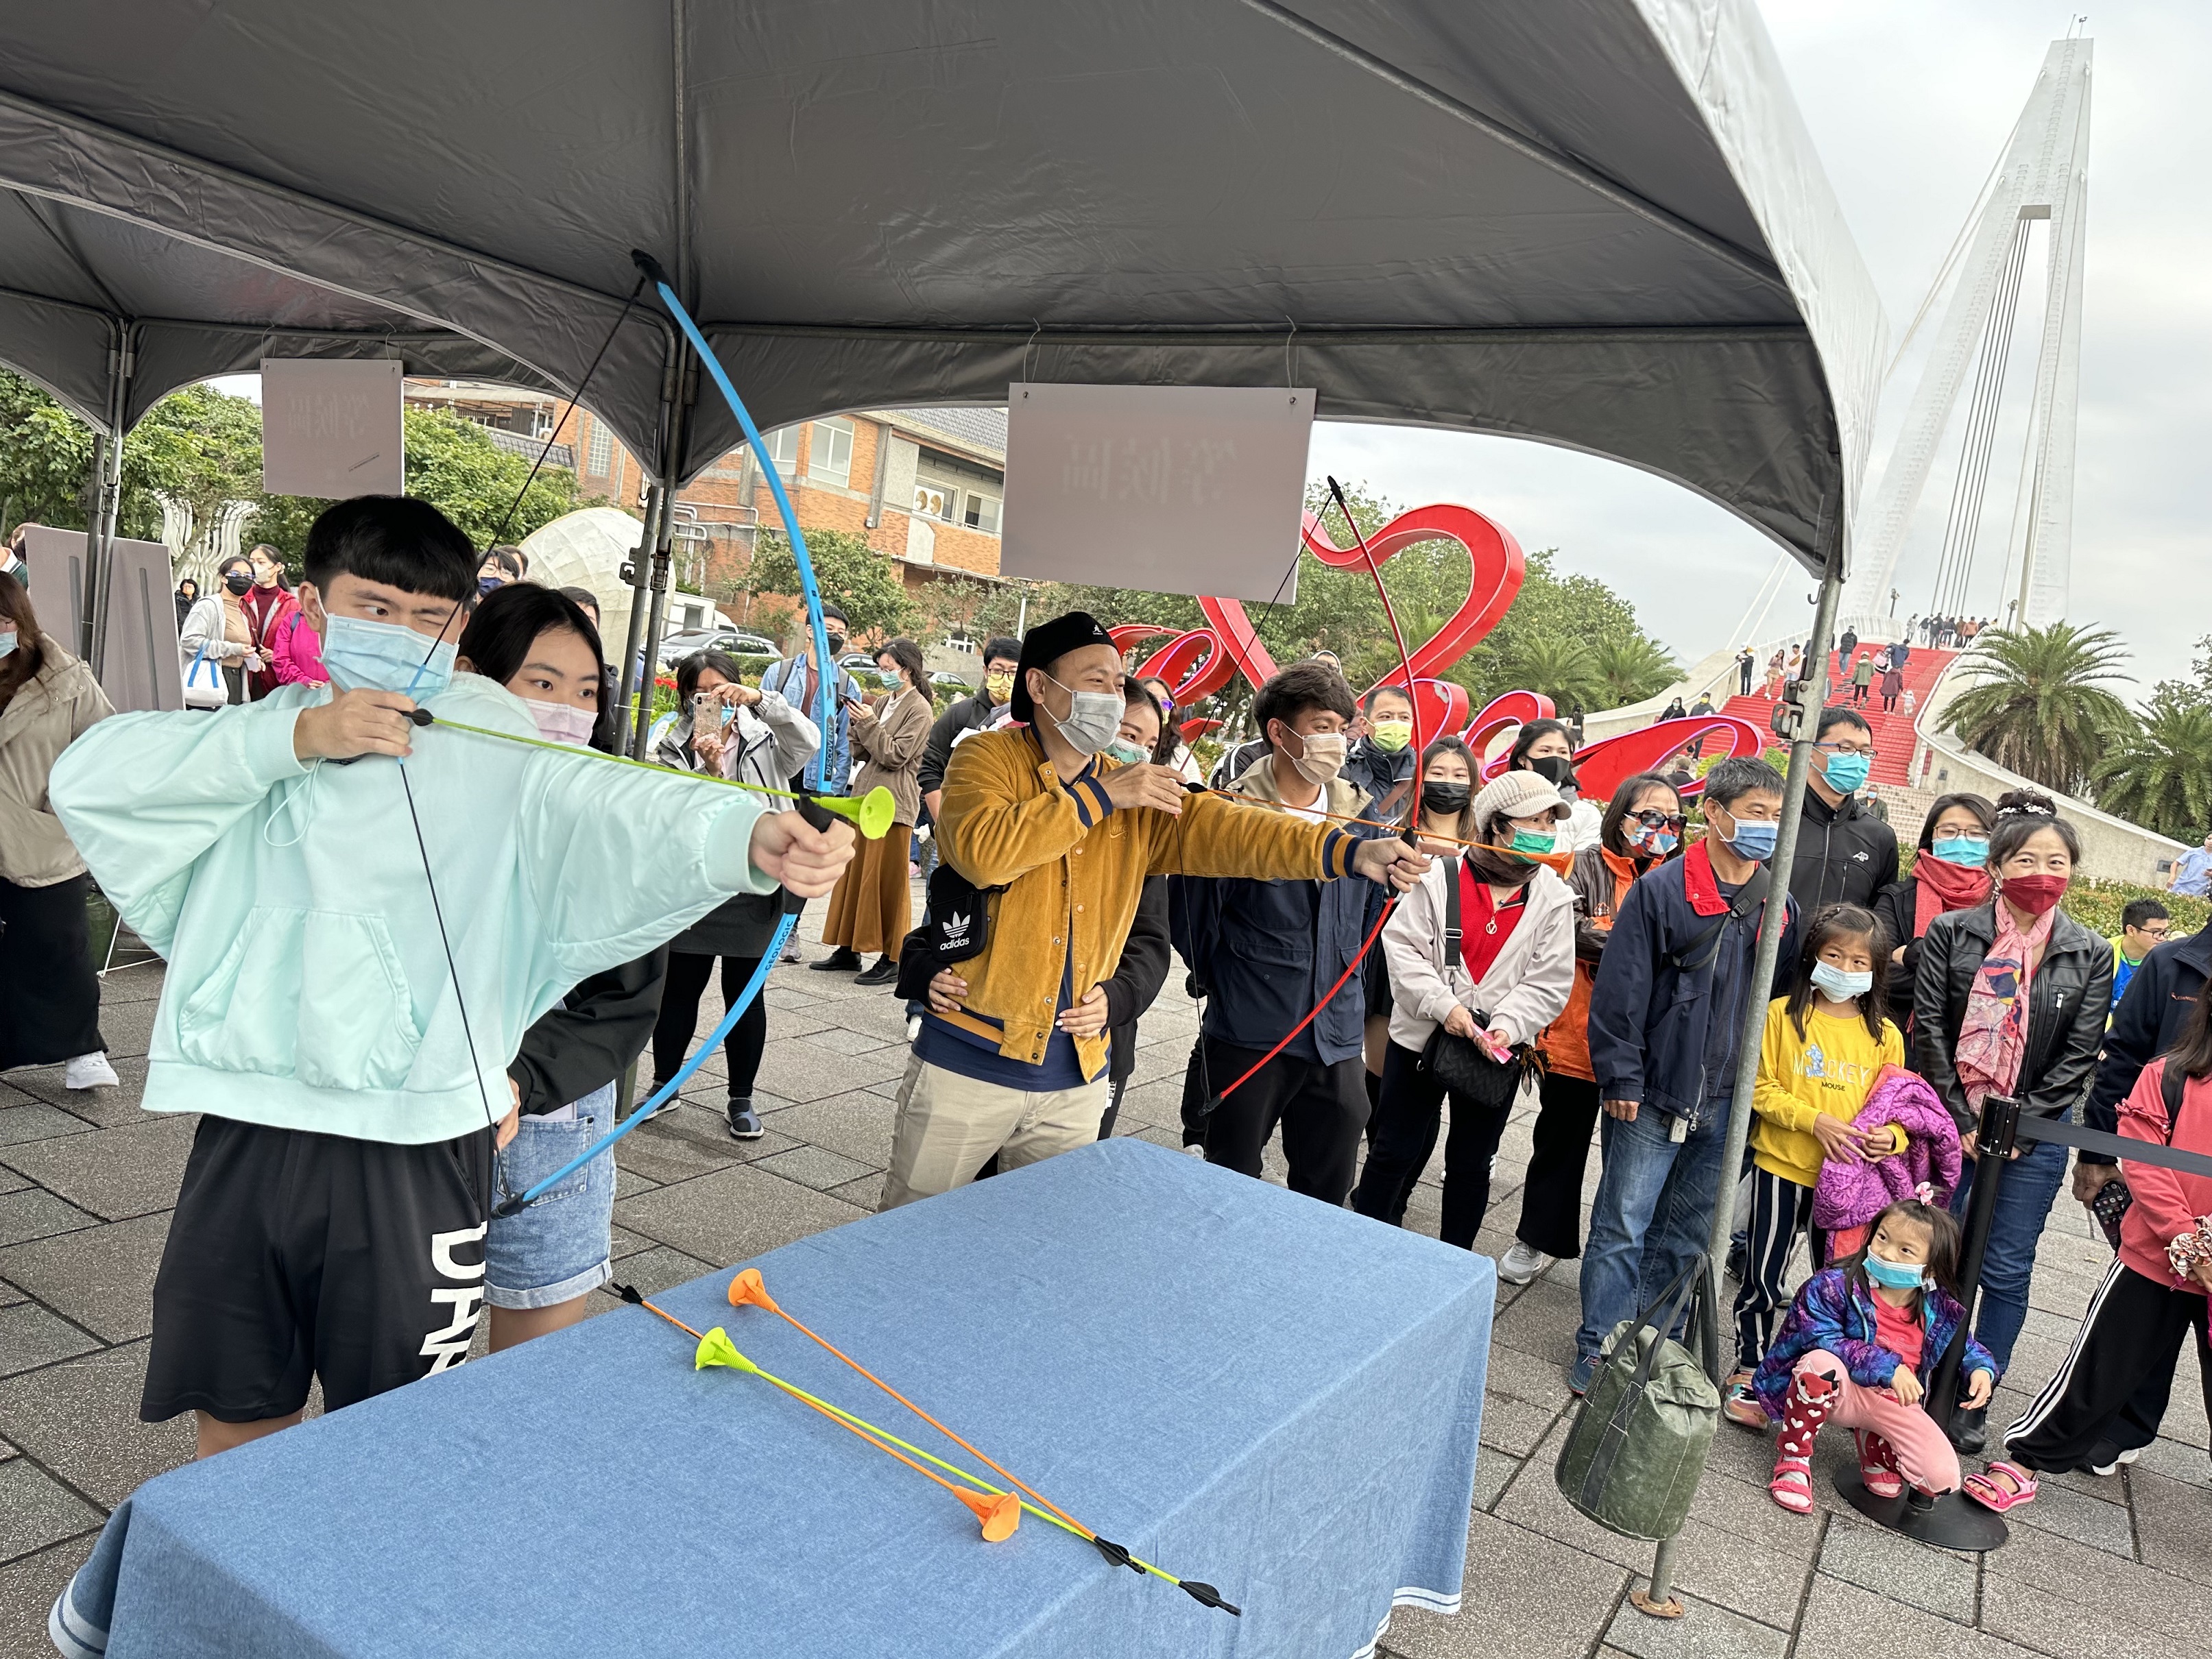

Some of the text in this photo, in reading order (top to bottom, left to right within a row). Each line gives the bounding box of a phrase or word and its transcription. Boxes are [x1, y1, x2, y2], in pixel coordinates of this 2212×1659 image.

[826, 723, 834, 775] DISCOVERY
[939, 937, 970, 951] adidas
[1793, 1051, 1871, 1087] MCKEY
[1821, 1081, 1846, 1091] MOUSE
